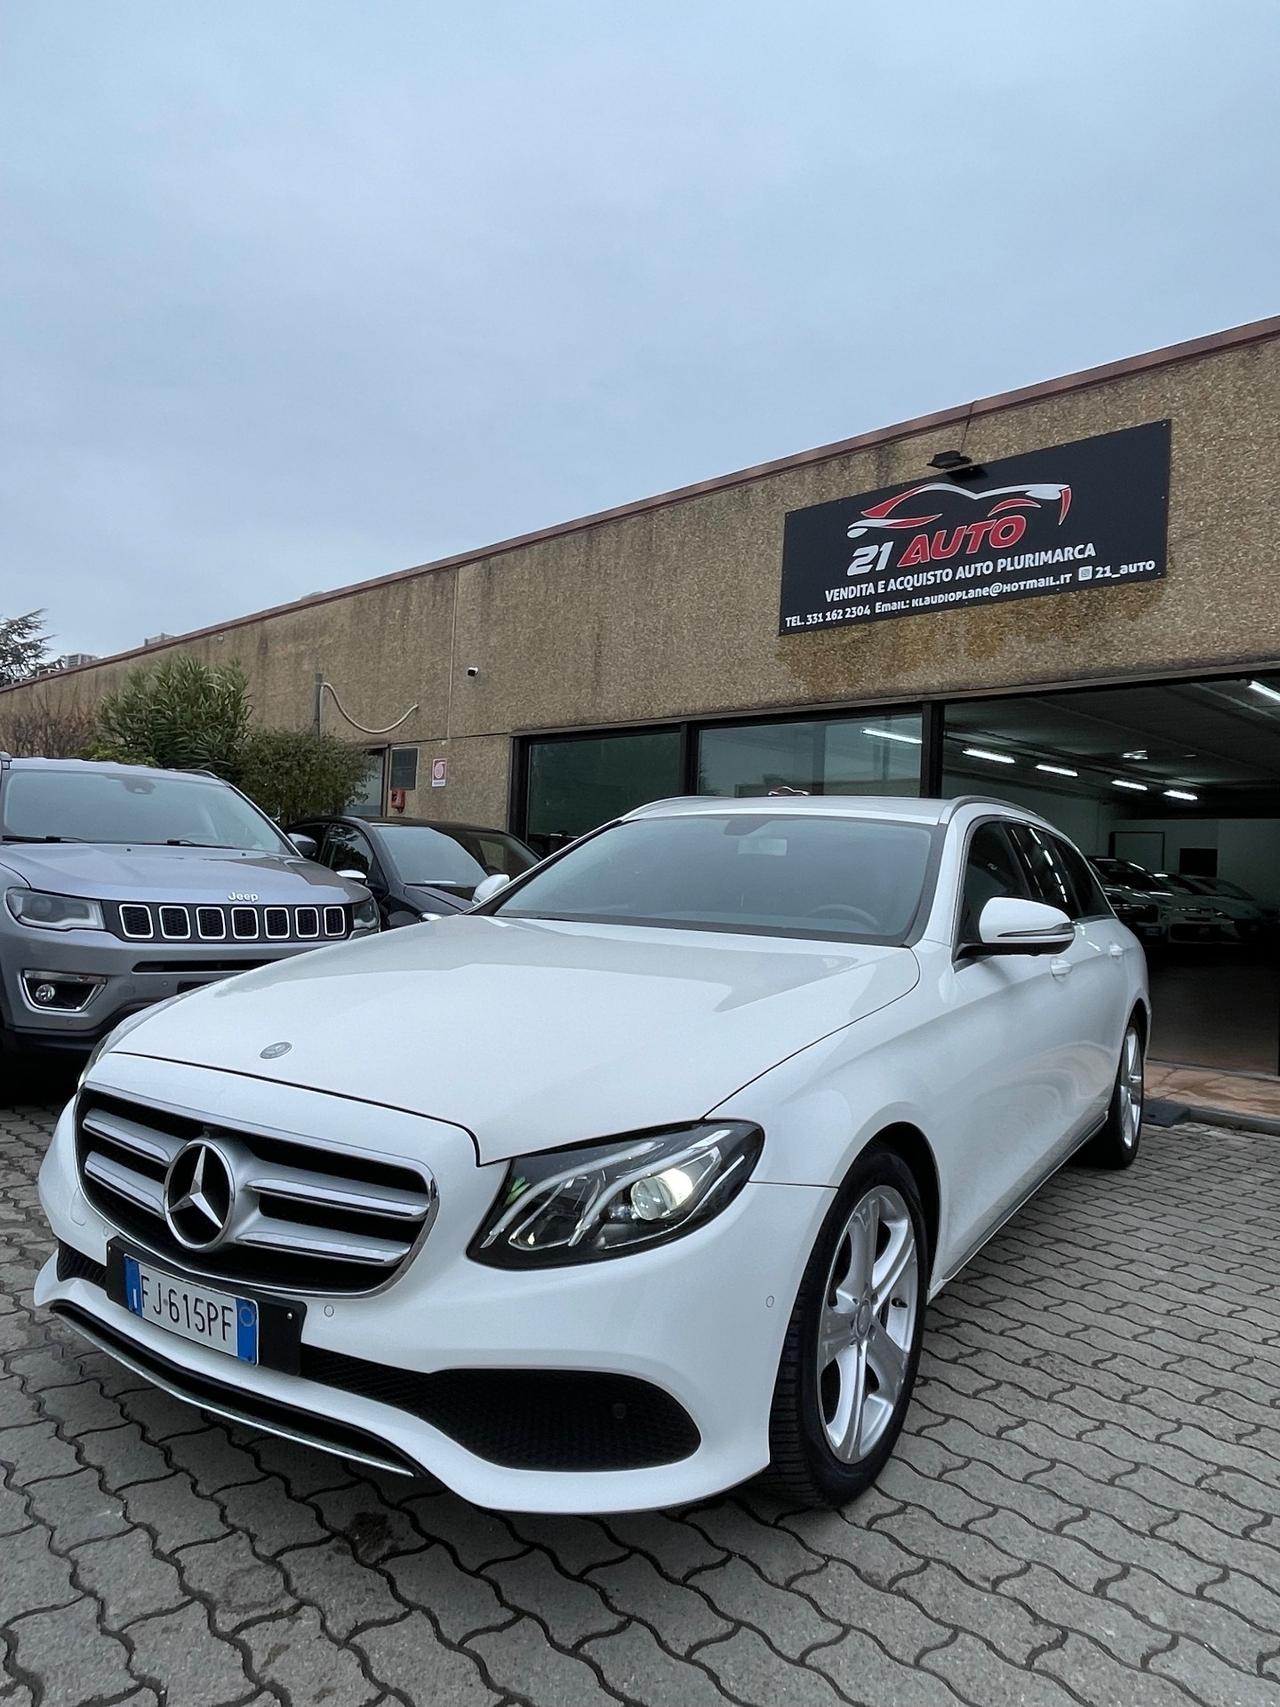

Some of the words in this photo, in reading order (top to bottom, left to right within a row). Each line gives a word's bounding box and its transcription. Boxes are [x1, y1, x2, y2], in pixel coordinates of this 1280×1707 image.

[846, 541, 894, 577] 21
[896, 514, 1027, 568] AUTO
[825, 583, 875, 603] VENDITA
[877, 580, 886, 594] E
[887, 568, 953, 592] ACQUISTO
[955, 561, 994, 580] AUTO
[996, 542, 1096, 573] PLURIMARCA
[785, 615, 805, 628] TEL.
[806, 612, 823, 625] 331
[825, 609, 843, 622] 162
[845, 604, 871, 620] 2304
[228, 891, 259, 903] Jeep
